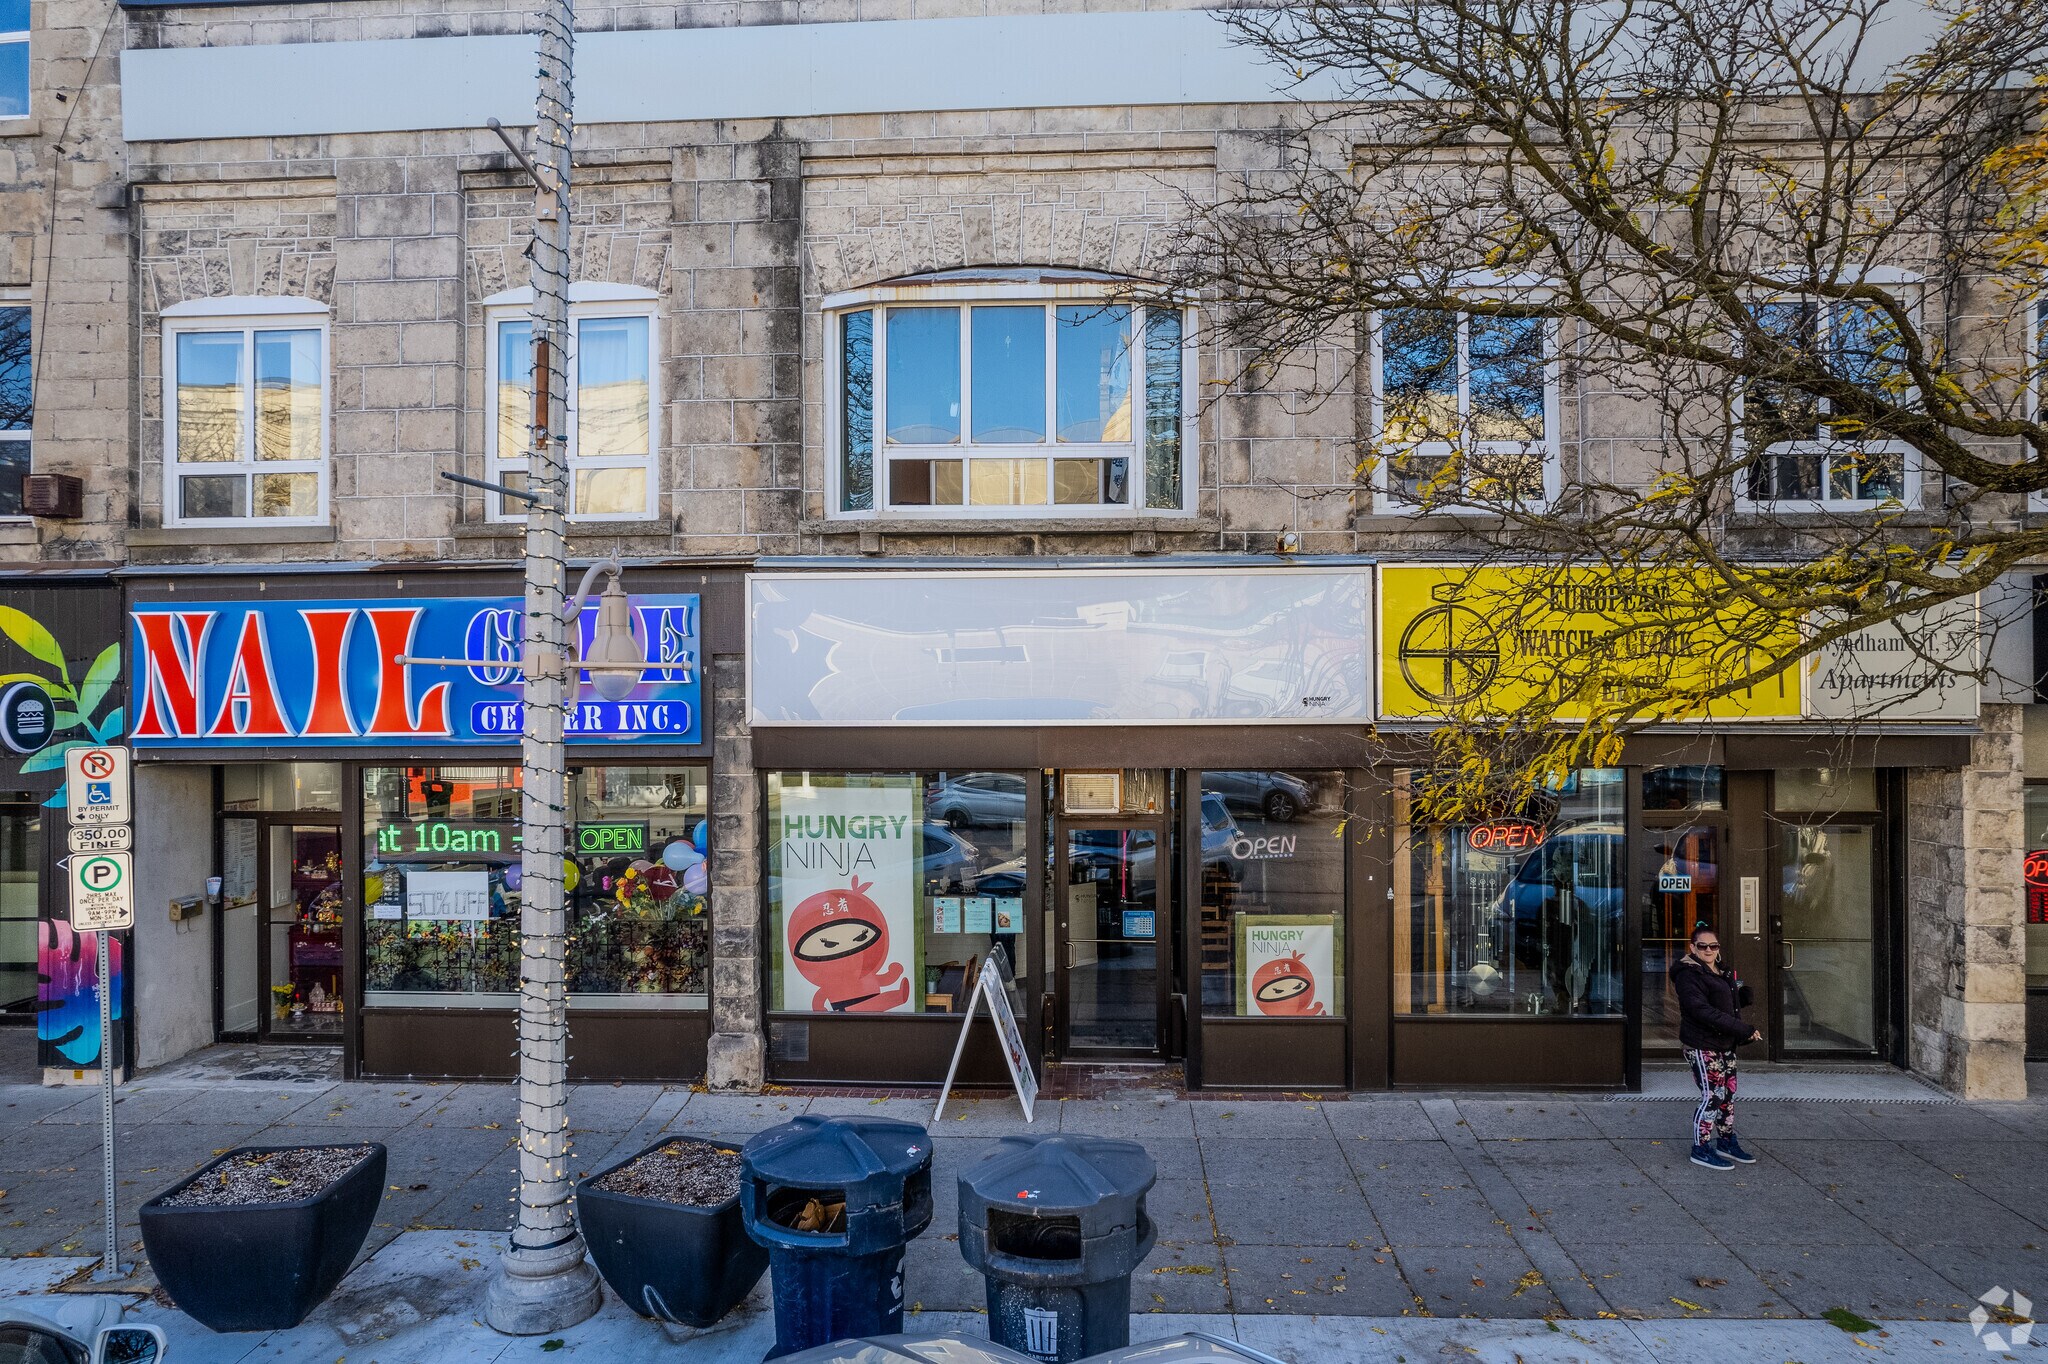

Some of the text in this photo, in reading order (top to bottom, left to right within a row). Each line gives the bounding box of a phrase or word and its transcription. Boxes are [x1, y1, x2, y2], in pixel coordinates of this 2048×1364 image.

[1519, 629, 1594, 657] WATCH
[129, 606, 693, 738] NAIL CE
[1818, 668, 1956, 699] Apartments
[481, 705, 681, 730] CEER INC.
[415, 823, 500, 852] 10am
[784, 815, 908, 839] HUNGRY
[1470, 825, 1547, 848] OPEN
[80, 841, 120, 849] FINE
[580, 829, 642, 850] OPEN
[1231, 835, 1296, 859] OPEN
[786, 842, 876, 876] NINJA
[94, 866, 110, 883] P
[1661, 877, 1690, 889] OPEN
[408, 889, 450, 916] 50%
[455, 889, 487, 915] OFF
[1252, 930, 1304, 940] HUNGRY
[1252, 942, 1291, 956] NINJA
